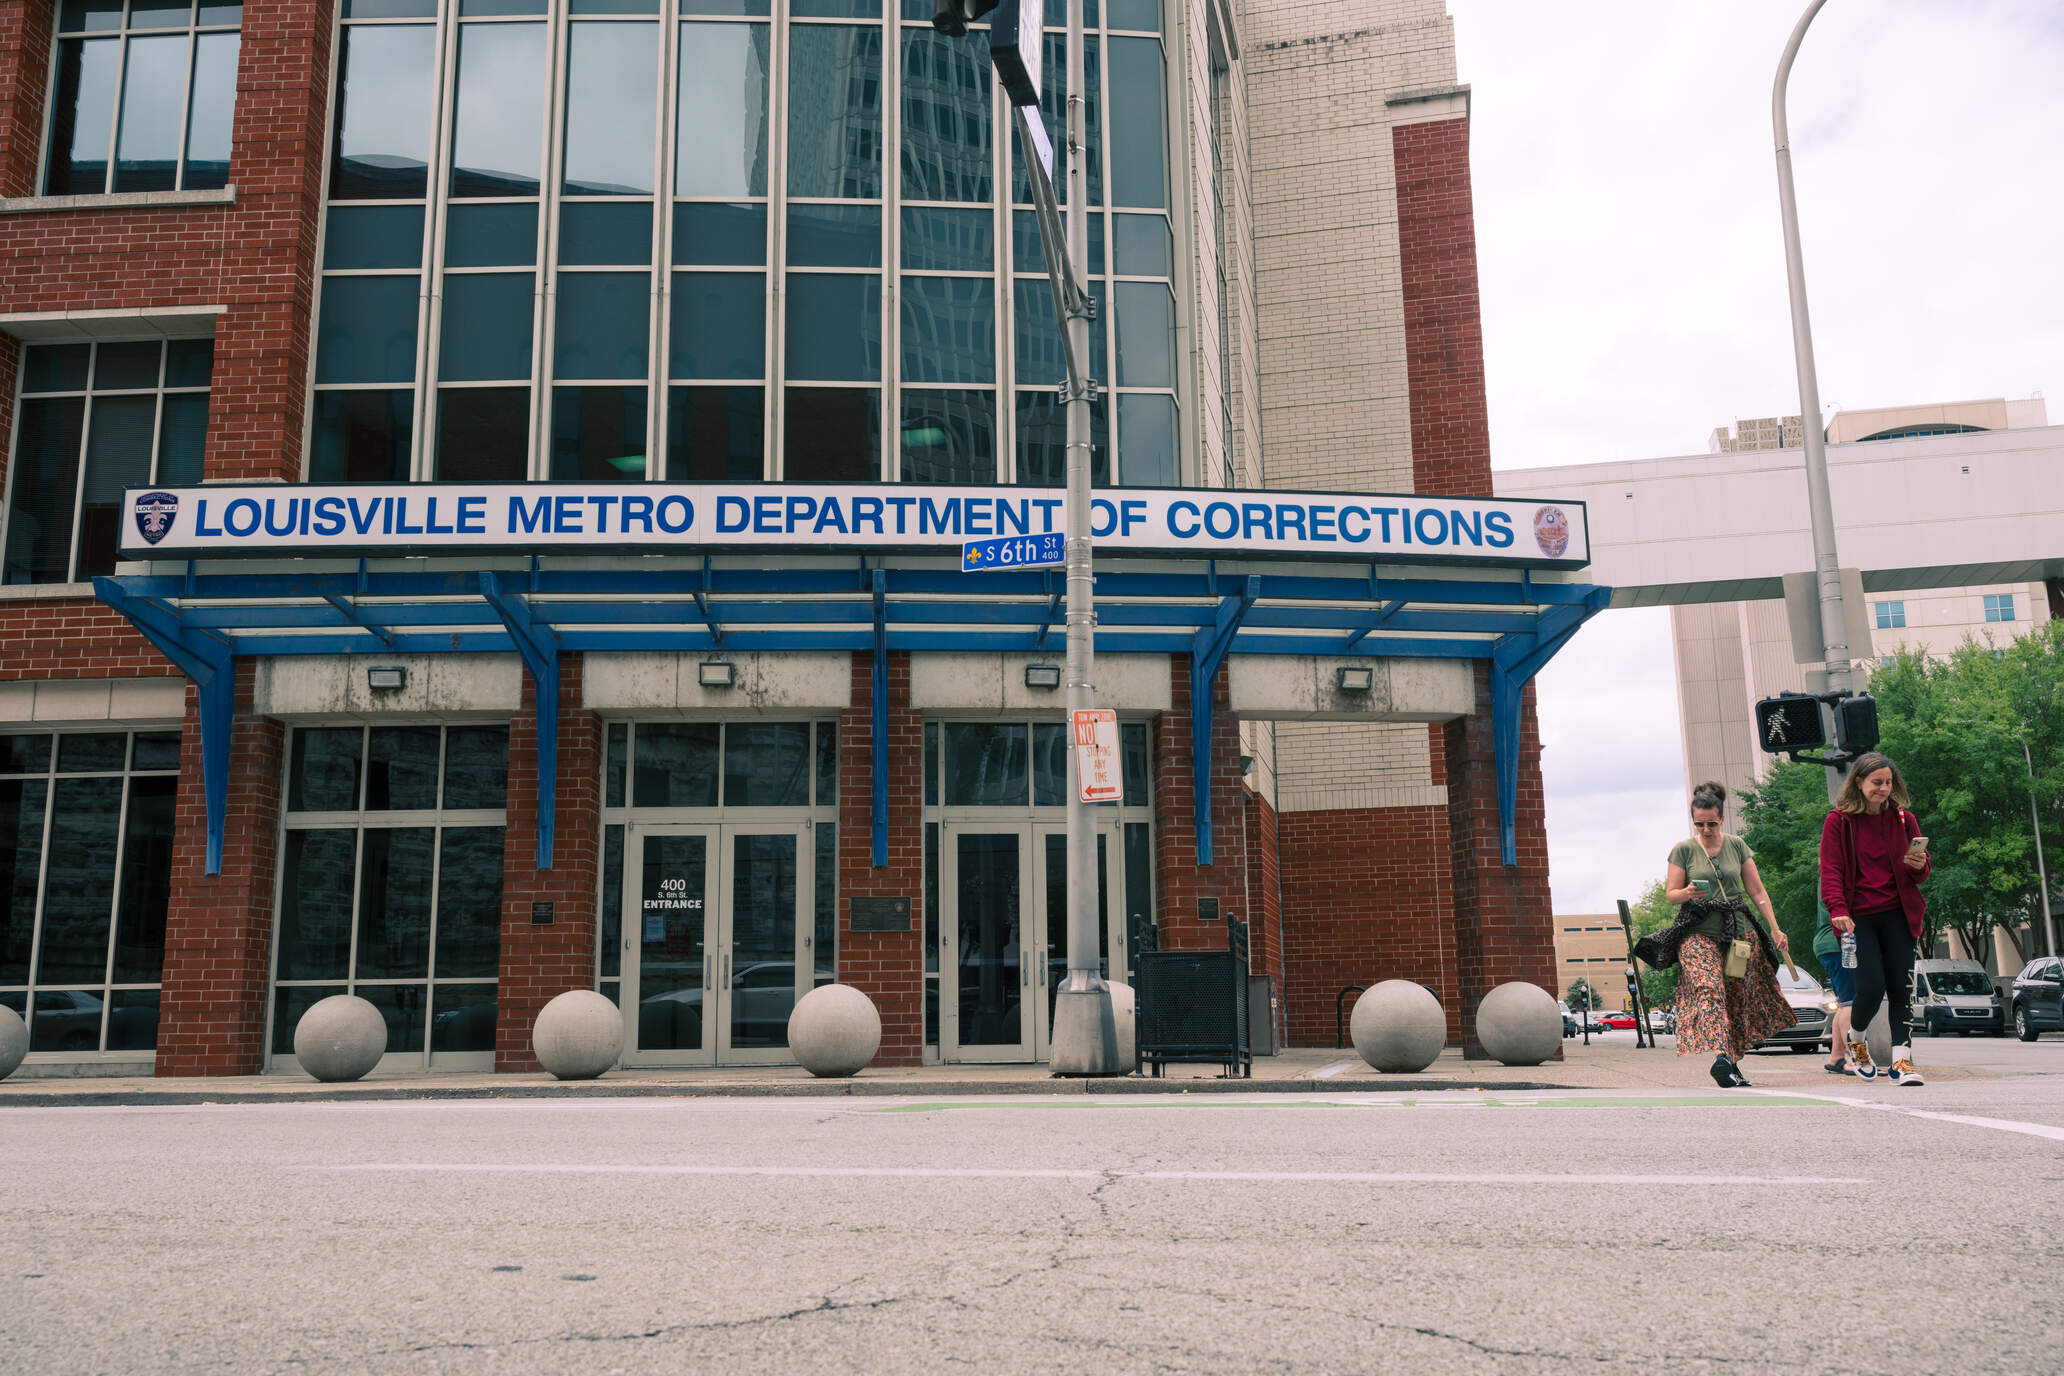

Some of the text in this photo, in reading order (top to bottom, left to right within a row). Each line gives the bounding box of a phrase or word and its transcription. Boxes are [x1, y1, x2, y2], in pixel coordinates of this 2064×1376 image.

[195, 497, 487, 537] LOUISVILLE
[507, 495, 695, 534] METRO
[716, 496, 1063, 535] DEPARTMENT
[1091, 499, 1147, 537] OF
[1166, 501, 1515, 548] CORRECTIONS
[986, 536, 1057, 563] S 6th St
[1042, 551, 1059, 560] 400
[1078, 723, 1094, 745] NO
[1094, 760, 1106, 770] ANY
[1095, 771, 1107, 783] TIME
[661, 879, 686, 891] 400
[643, 900, 702, 909] ENTRANCE
